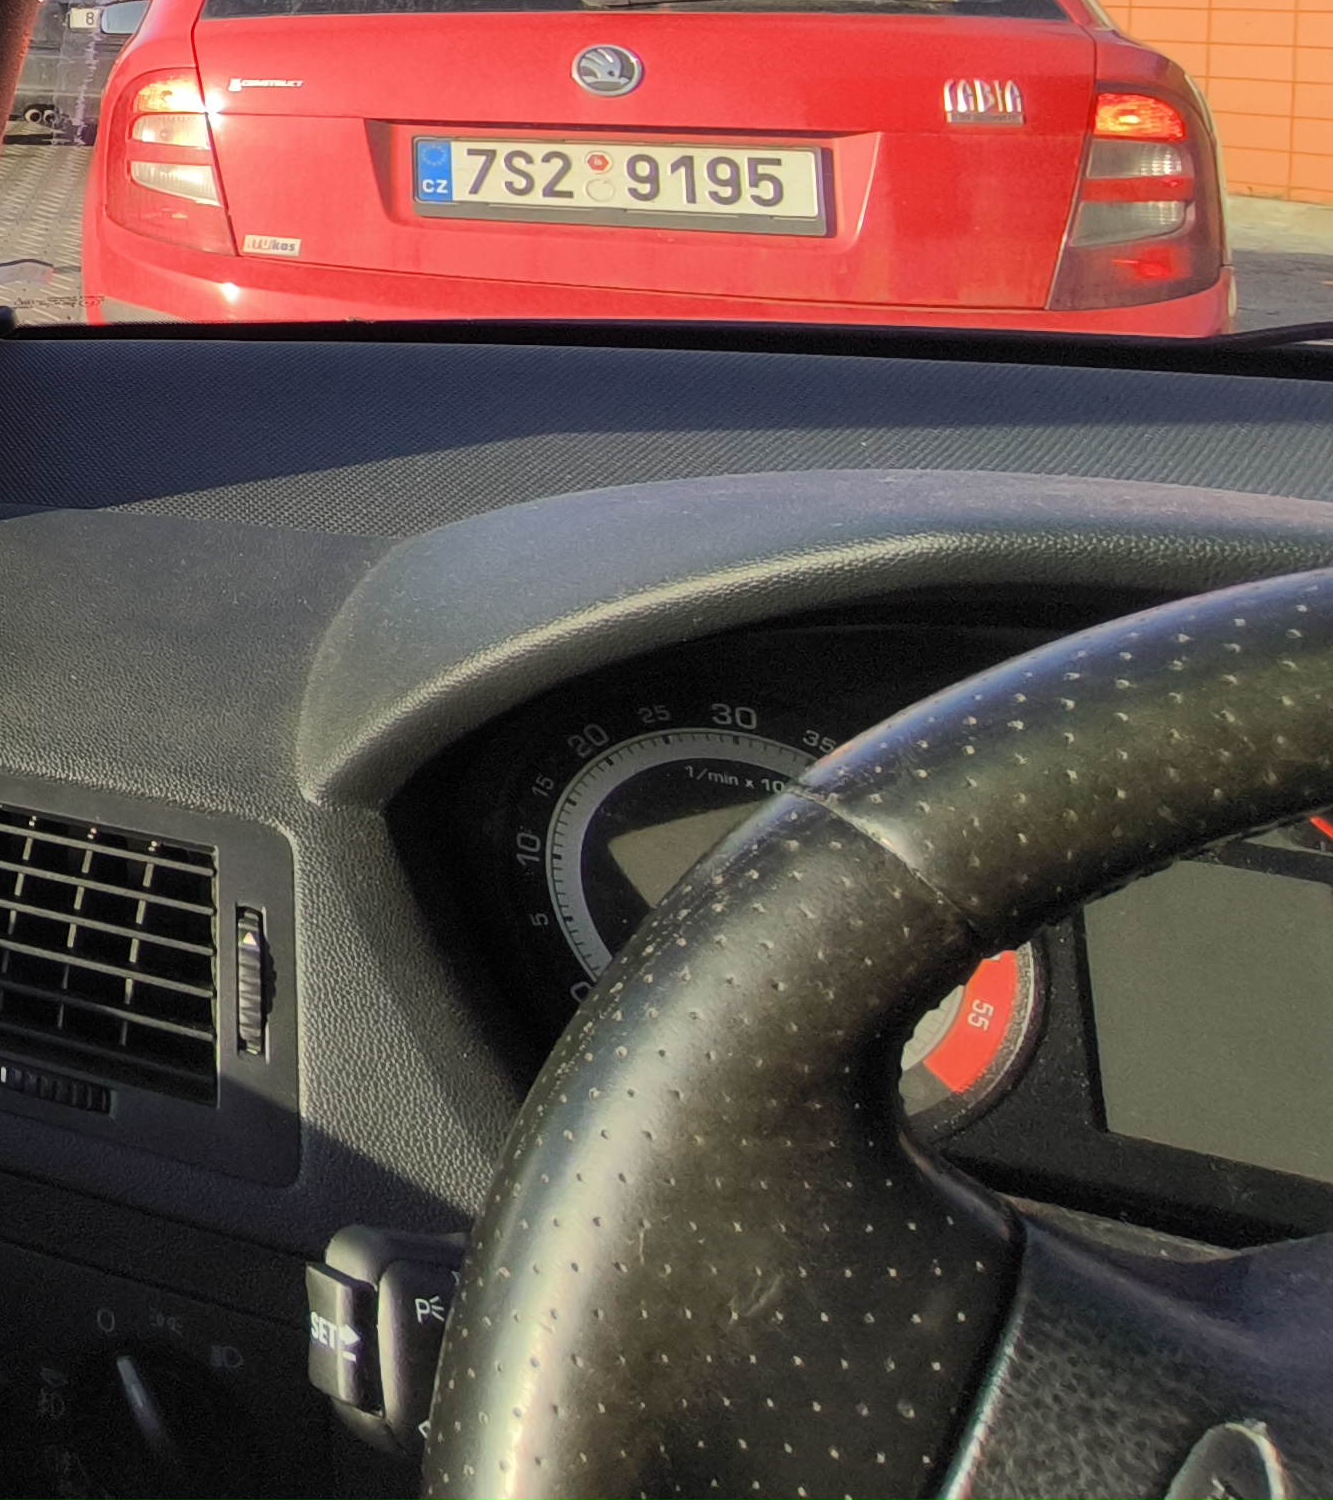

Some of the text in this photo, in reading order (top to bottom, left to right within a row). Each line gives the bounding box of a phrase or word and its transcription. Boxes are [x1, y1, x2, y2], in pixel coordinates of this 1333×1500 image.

[422, 178, 448, 194] CZ
[465, 148, 784, 208] 7S2 9195
[638, 705, 671, 724] 25
[711, 703, 757, 730] 30
[567, 723, 610, 758] 20
[802, 729, 837, 754] 35
[532, 776, 554, 797] 15
[685, 766, 739, 786] 1/min
[516, 832, 541, 866] 10
[530, 913, 549, 926] 5
[967, 999, 995, 1031] 55
[310, 1311, 337, 1350] SET
